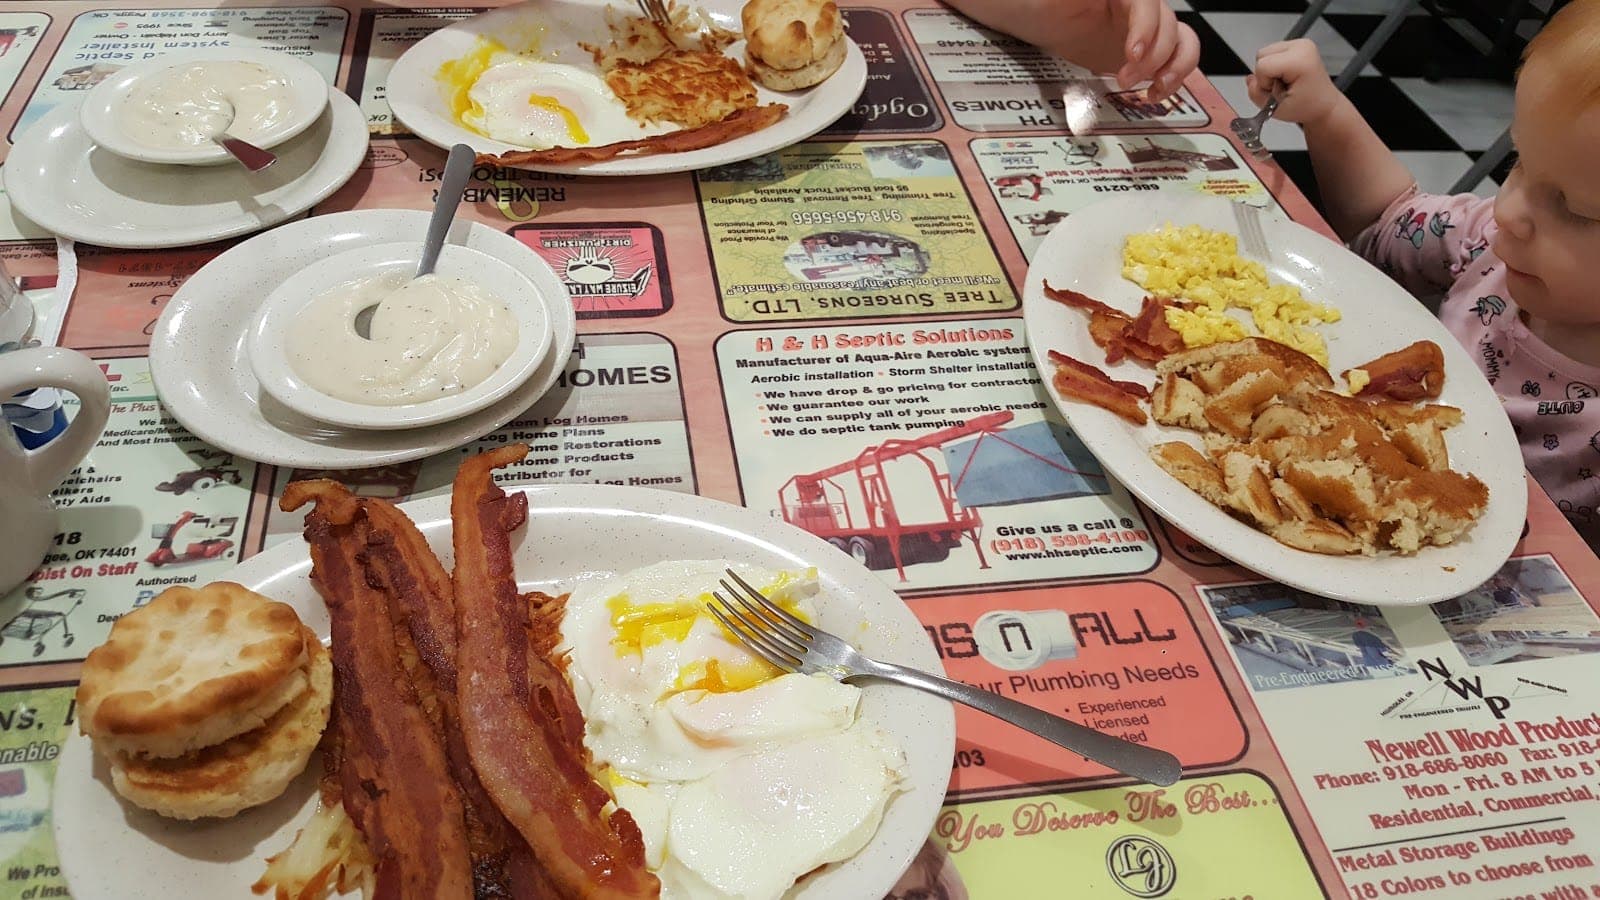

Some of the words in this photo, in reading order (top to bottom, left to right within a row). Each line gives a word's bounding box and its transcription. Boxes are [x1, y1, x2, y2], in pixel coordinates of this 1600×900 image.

[80, 42, 155, 50] Installer
[75, 51, 134, 60] Septic
[952, 100, 1040, 112] HOMES
[369, 114, 388, 122] OK
[1018, 115, 1054, 126] PH
[418, 167, 520, 182] TROS!
[754, 188, 801, 196] Available
[834, 186, 870, 194] Bucket
[1092, 183, 1160, 193] 686-0218
[432, 187, 566, 203] REMEMBR
[711, 196, 758, 206] Grinding
[760, 196, 796, 204] Stump
[802, 195, 849, 203] Removal
[850, 194, 874, 202] Tree
[882, 192, 931, 201] Trimming
[932, 192, 956, 200] Tree
[790, 208, 901, 226] 918-456-5656
[910, 215, 951, 223] Removal
[713, 222, 758, 230] Protection
[914, 220, 964, 230] Dangerous
[727, 228, 766, 236] Insurance
[920, 227, 976, 236] Specializing
[543, 240, 600, 248] PUNISHER
[604, 240, 631, 248] DIRT
[720, 236, 742, 244] Proof
[128, 280, 181, 290] Systems
[792, 281, 861, 293] reasonable
[862, 278, 884, 289] any
[886, 279, 915, 288] beat
[918, 278, 930, 287] or
[932, 276, 963, 287] meet
[582, 284, 602, 296] WAY
[744, 300, 801, 314] LTD.
[755, 337, 773, 352] H
[782, 336, 804, 350] &
[811, 332, 828, 350] H
[835, 330, 905, 348] Septic
[911, 328, 1014, 347] Solutions
[735, 356, 832, 368] Manufacturer
[836, 354, 850, 364] of
[854, 351, 924, 365] Aqua-Aire
[926, 348, 980, 360] Aerobic
[1482, 341, 1501, 379] MOMMY
[750, 372, 800, 384] Aerobic
[804, 369, 874, 382] installation
[888, 366, 926, 378] Storm
[929, 364, 973, 375] Shelter
[764, 390, 786, 400] We
[789, 388, 822, 398] have
[826, 386, 858, 398] drop
[862, 385, 874, 394] &
[876, 386, 894, 397] go
[898, 382, 946, 396] pricing
[948, 380, 967, 390] for
[129, 402, 156, 412] Plus
[766, 402, 789, 412] We
[792, 400, 864, 412] guarantee
[868, 399, 892, 407] our
[894, 395, 930, 406] work
[1536, 400, 1584, 416] CUTE
[769, 415, 792, 424] We
[795, 414, 822, 423] can
[826, 411, 872, 424] supply
[876, 409, 894, 418] all
[896, 408, 912, 418] of
[915, 407, 946, 418] your
[950, 404, 1002, 416] aerobic
[1006, 401, 1048, 412] needs
[139, 418, 156, 426] We
[544, 416, 572, 427] Log
[576, 414, 628, 424] Homes
[513, 430, 558, 440] Home
[562, 427, 605, 438] Plans
[772, 428, 796, 438] We
[798, 426, 818, 436] do
[820, 423, 866, 438] septic
[869, 420, 902, 432] tank
[904, 418, 966, 432] pumping
[96, 438, 120, 448] And
[122, 436, 152, 446] Most
[563, 437, 662, 451] Restorations
[564, 452, 634, 464] Products
[568, 468, 592, 478] for
[628, 474, 682, 486] Homes
[80, 495, 111, 505] Aids
[996, 524, 1036, 537] Give
[1040, 524, 1062, 534] us
[1068, 524, 1080, 532] a
[1083, 519, 1117, 530] call
[54, 531, 82, 547] 18
[990, 536, 1046, 554] (918)
[1050, 529, 1150, 548] 598-4100
[75, 549, 97, 561] OK
[100, 546, 137, 559] 74401
[1006, 544, 1144, 561] www.hhseptic.com
[71, 564, 92, 579] On
[97, 562, 139, 578] Staff
[136, 574, 198, 587] Authorized
[1068, 608, 1178, 648] ALL
[1008, 666, 1120, 695] Plumbing
[1122, 662, 1200, 684] Needs
[1255, 663, 1356, 690] Pre-Engineered
[1078, 696, 1168, 715] Experienced
[1084, 714, 1150, 732] Licensed
[1364, 731, 1451, 764] Newell
[1446, 723, 1520, 752] Wood
[1313, 770, 1382, 790] Phone:
[1382, 752, 1508, 781] 918-686-8060
[1518, 744, 1558, 762] Fax:
[1402, 784, 1450, 800] Mon
[1464, 774, 1500, 792] Fri.
[1501, 772, 1518, 787] 8
[1520, 768, 1553, 785] AM
[1554, 764, 1577, 780] to
[1578, 762, 1595, 776] 5
[1368, 800, 1484, 830] Residential,
[1482, 784, 1600, 813] Commercial,
[935, 810, 1005, 854] You
[1012, 801, 1120, 838] Deserve
[1124, 788, 1178, 823] The
[1184, 782, 1278, 816] Best...
[1337, 850, 1398, 873] Metal
[1400, 840, 1480, 864] Storage
[1480, 826, 1576, 852] Buildings
[8, 867, 31, 882] We
[34, 864, 60, 879] Pro
[1350, 882, 1379, 900] 18
[1380, 873, 1445, 896] Colors
[1448, 868, 1472, 886] to
[1475, 861, 1544, 883] choose
[1545, 852, 1594, 873] from
[21, 888, 39, 900] of
[1540, 884, 1588, 900] with
